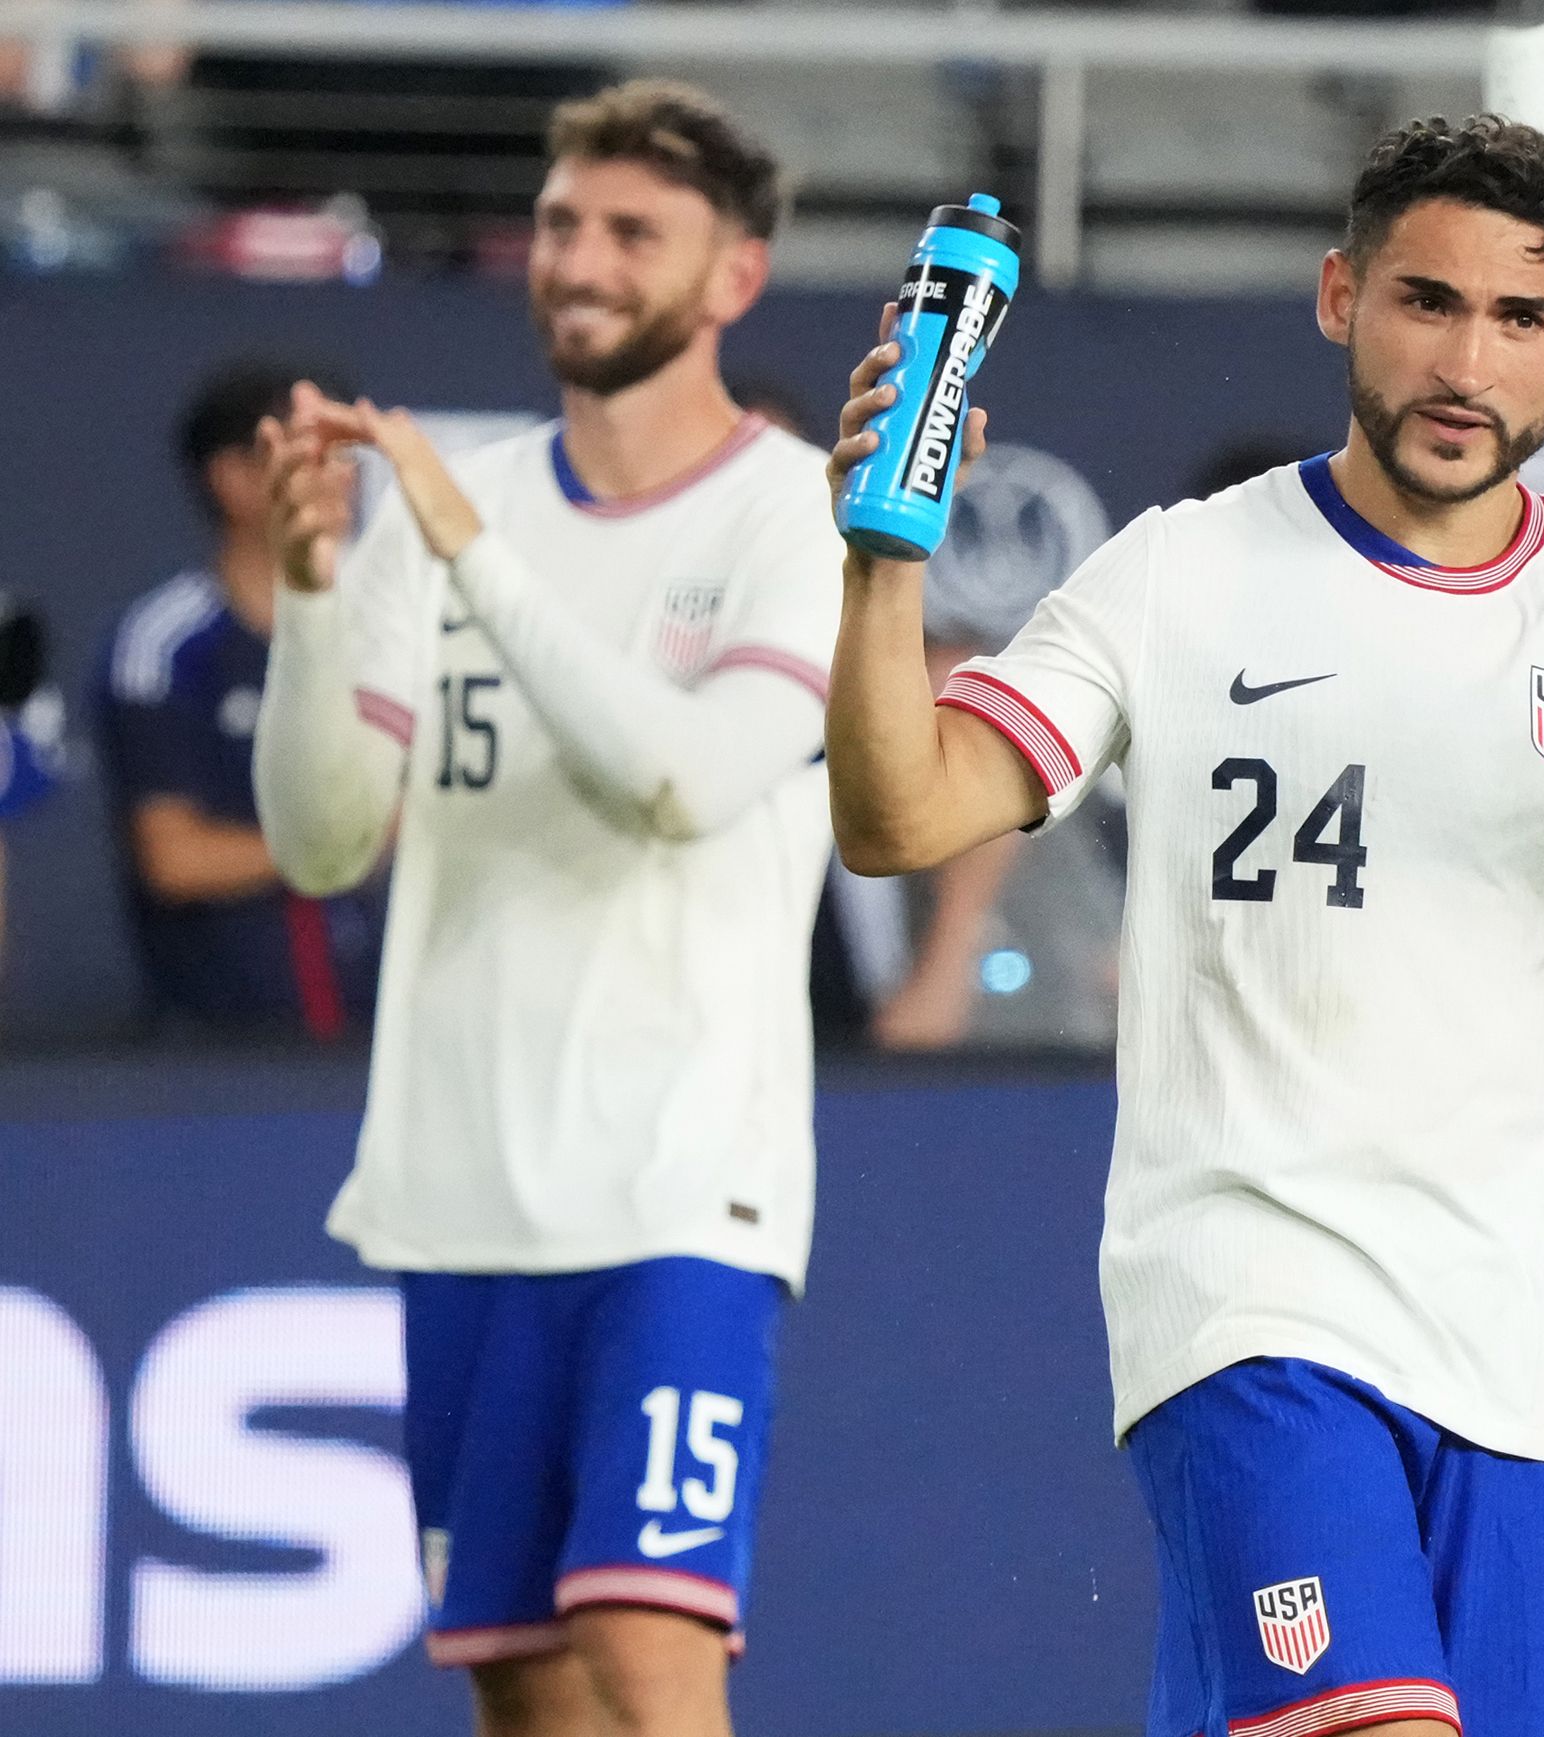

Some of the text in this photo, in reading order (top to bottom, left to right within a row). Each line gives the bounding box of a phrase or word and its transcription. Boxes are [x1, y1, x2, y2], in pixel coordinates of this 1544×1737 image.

[899, 280, 947, 300] ERADE
[910, 284, 994, 496] POWERADE
[436, 676, 501, 788] 15
[1212, 758, 1367, 908] 24
[637, 1386, 743, 1521] 15
[1258, 1582, 1318, 1621] USA
